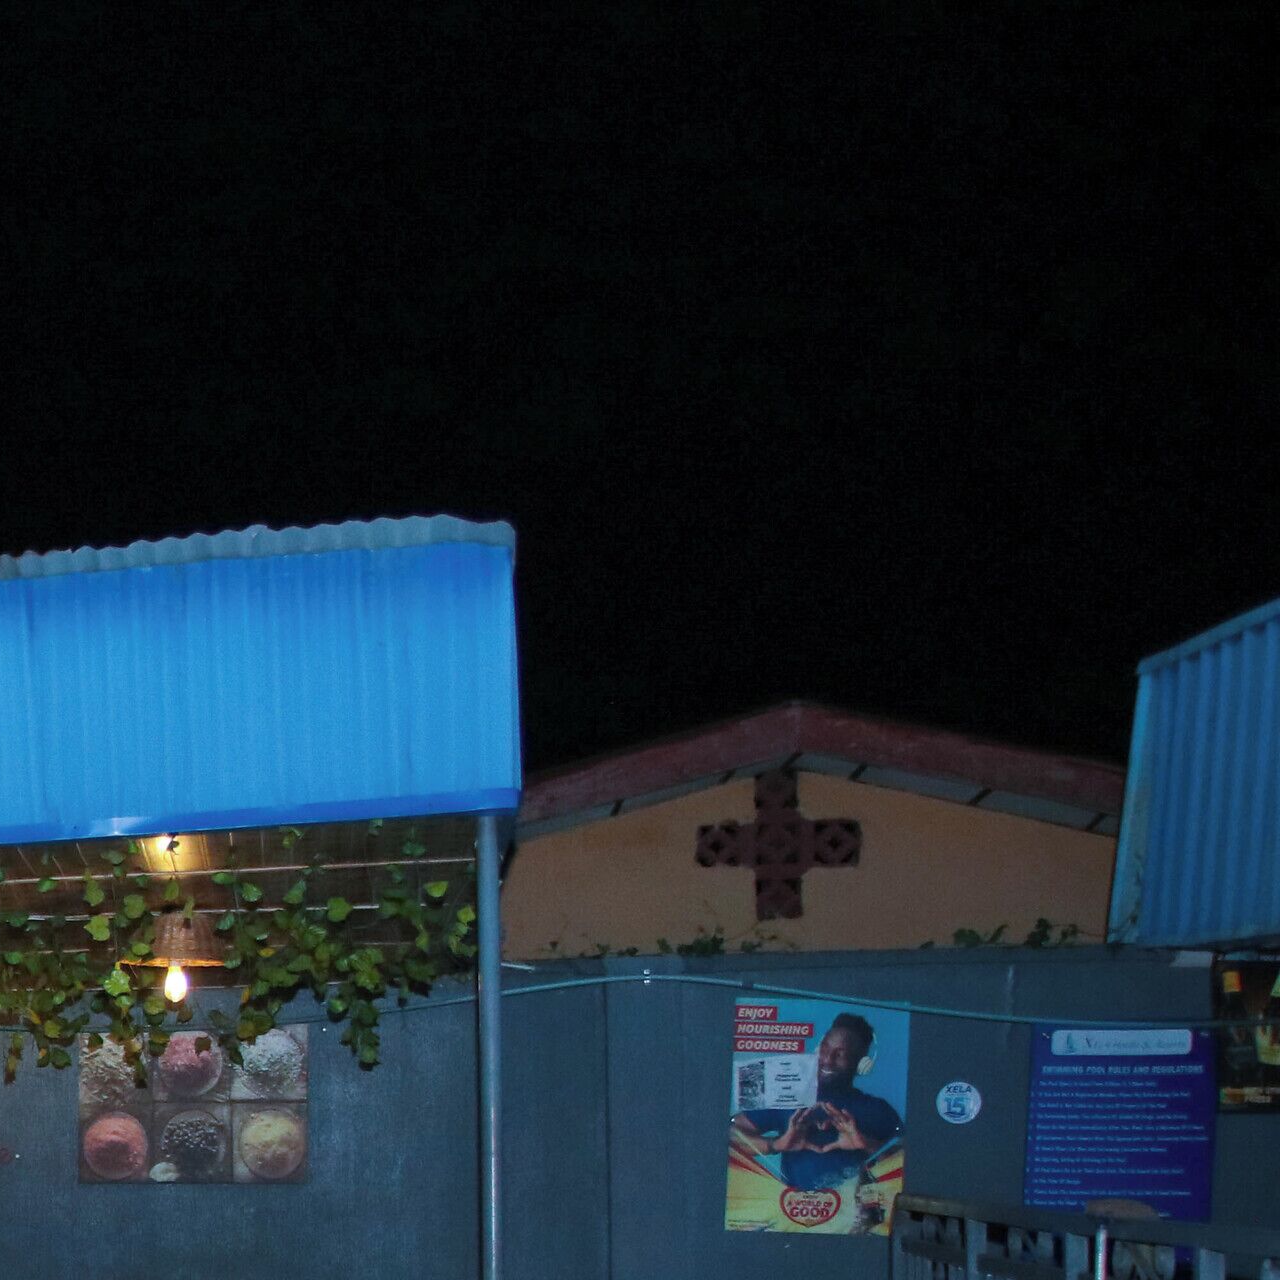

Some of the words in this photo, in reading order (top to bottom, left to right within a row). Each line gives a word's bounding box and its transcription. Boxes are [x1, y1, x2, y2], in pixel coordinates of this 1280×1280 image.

[738, 1008, 773, 1019] ENJOY
[736, 1024, 809, 1035] NOURISHING
[736, 1040, 799, 1051] GOODNESS
[790, 1207, 830, 1218] GOOD
